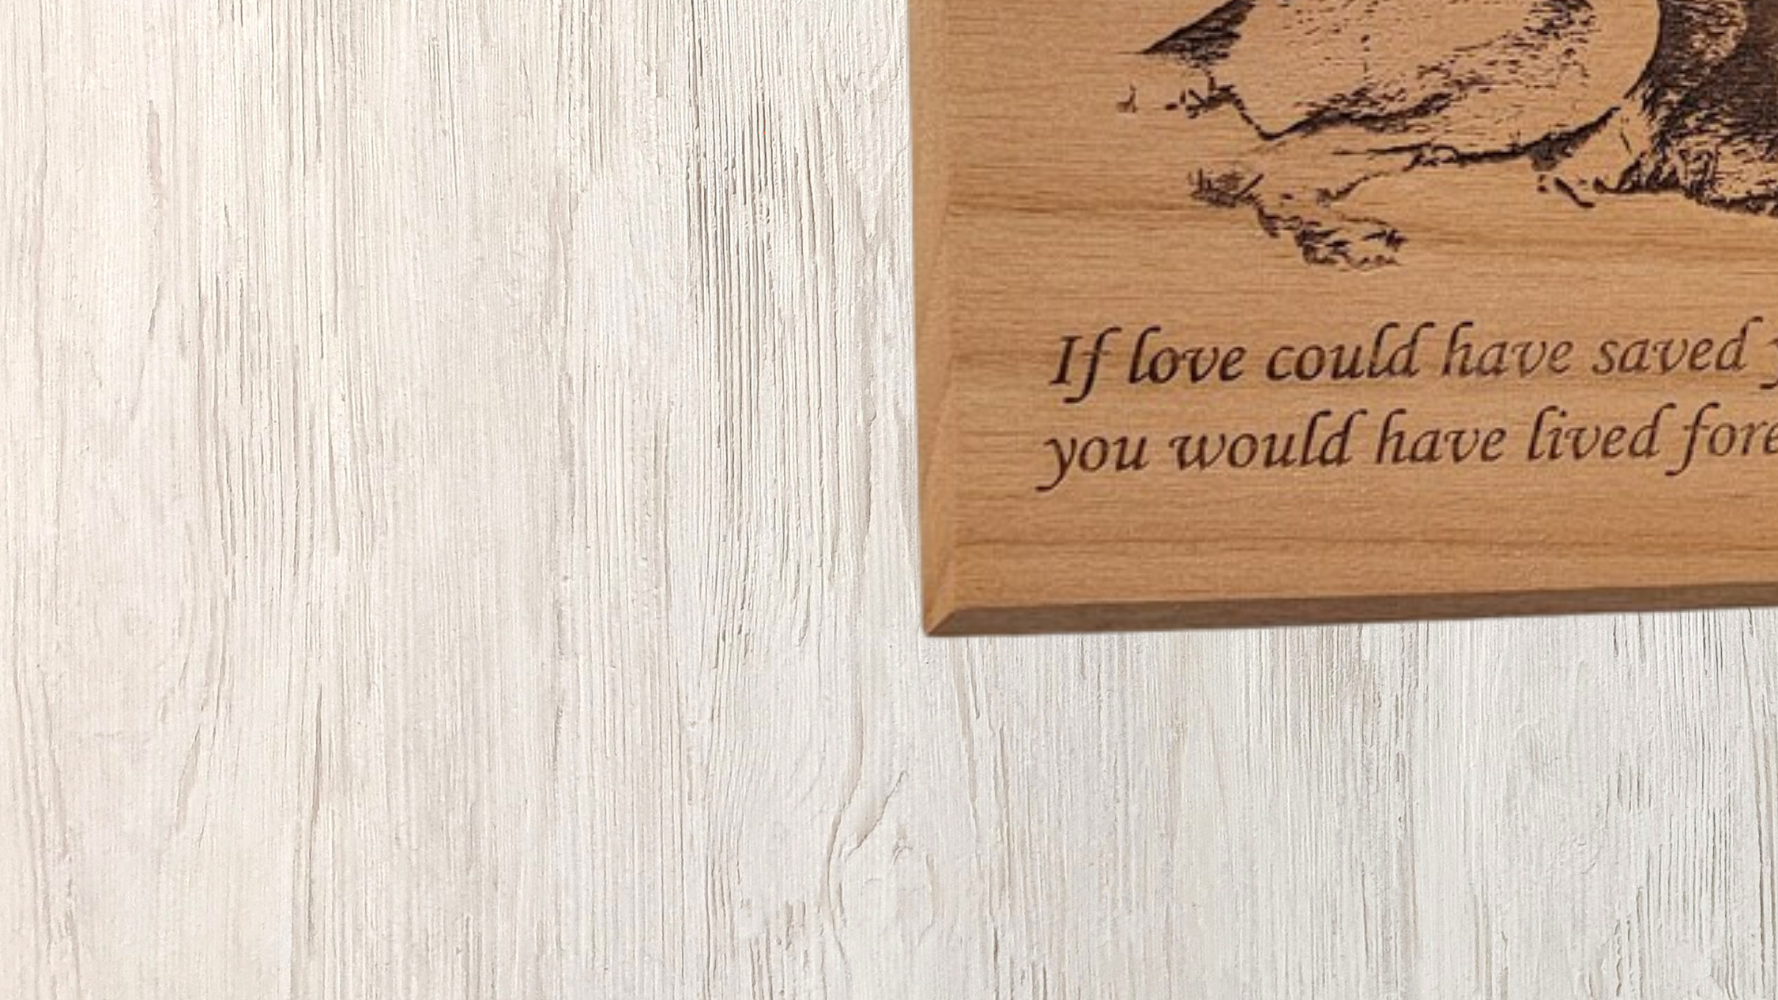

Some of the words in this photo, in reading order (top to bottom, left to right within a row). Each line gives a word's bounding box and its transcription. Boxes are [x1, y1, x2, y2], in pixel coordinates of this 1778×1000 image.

[1048, 326, 1122, 403] If
[1128, 325, 1247, 385] love
[1266, 321, 1435, 381] could
[1441, 320, 1574, 379] have
[1592, 316, 1764, 377] saved
[1035, 436, 1149, 492] you
[1168, 410, 1368, 471] would
[1374, 408, 1507, 464] have
[1526, 402, 1677, 461] lived
